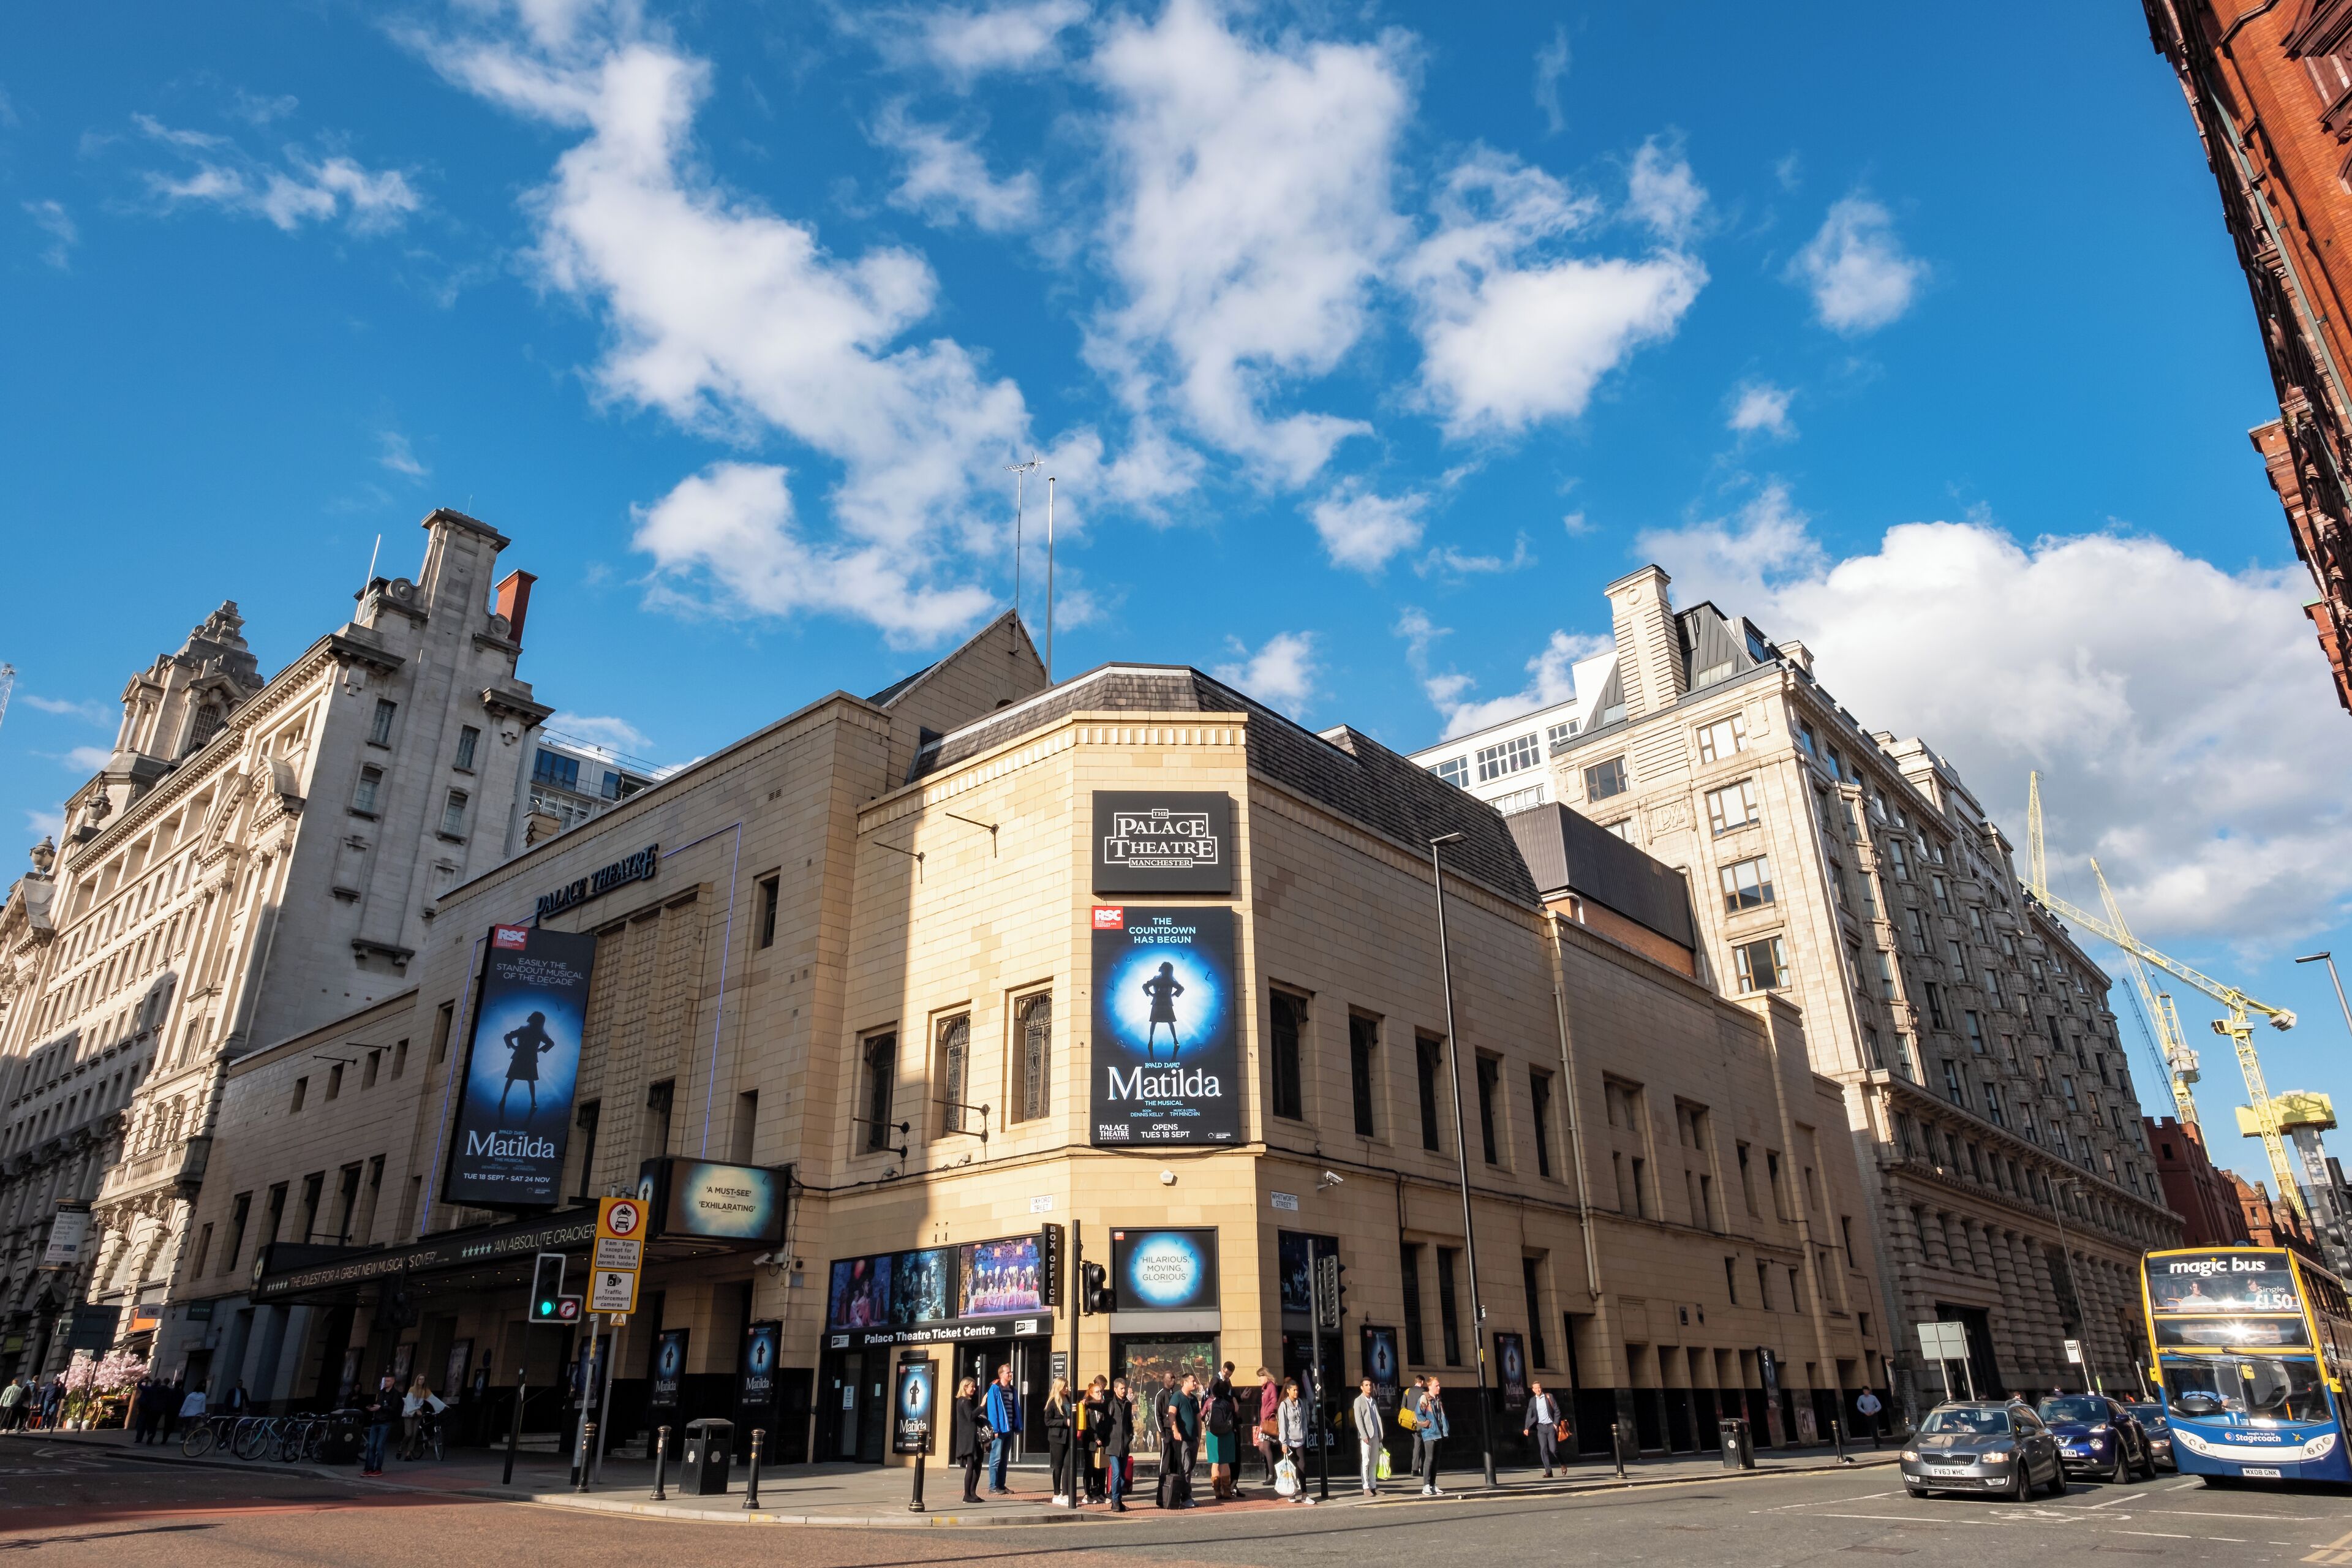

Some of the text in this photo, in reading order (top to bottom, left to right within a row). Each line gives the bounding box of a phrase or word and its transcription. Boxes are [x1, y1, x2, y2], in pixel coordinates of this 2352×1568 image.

[1118, 818, 1205, 837] PALACE
[1110, 840, 1214, 858] THEATRE
[532, 843, 659, 929] PALACE THEATRE
[1095, 910, 1121, 921] RSC
[497, 929, 526, 943] RSC
[496, 963, 584, 979] STANDOUT MUSICAL
[550, 961, 567, 970] THE
[1107, 1066, 1223, 1100] Matilda
[466, 1130, 555, 1158] Matilda
[1031, 1196, 1051, 1205] OXFORD
[1272, 1194, 1297, 1202] WHITWORTH
[507, 1231, 552, 1251] ABSOLUTE
[554, 1224, 597, 1243] CRACKER
[302, 1272, 321, 1286] QUEST
[322, 1270, 334, 1283] FOR
[335, 1269, 339, 1280] A
[341, 1265, 361, 1280] GREAT
[361, 1262, 378, 1275] NEW
[378, 1257, 405, 1273] MUSICA
[2169, 1257, 2266, 1276] magic bus
[2255, 1294, 2293, 1310] £1.50
[864, 1325, 996, 1344] Palace Theatre Ticket Centre
[655, 1381, 676, 1392] Matilda
[746, 1378, 769, 1390] Matilda
[899, 1419, 927, 1434] Matilda
[2236, 1434, 2281, 1443] Stagecoach
